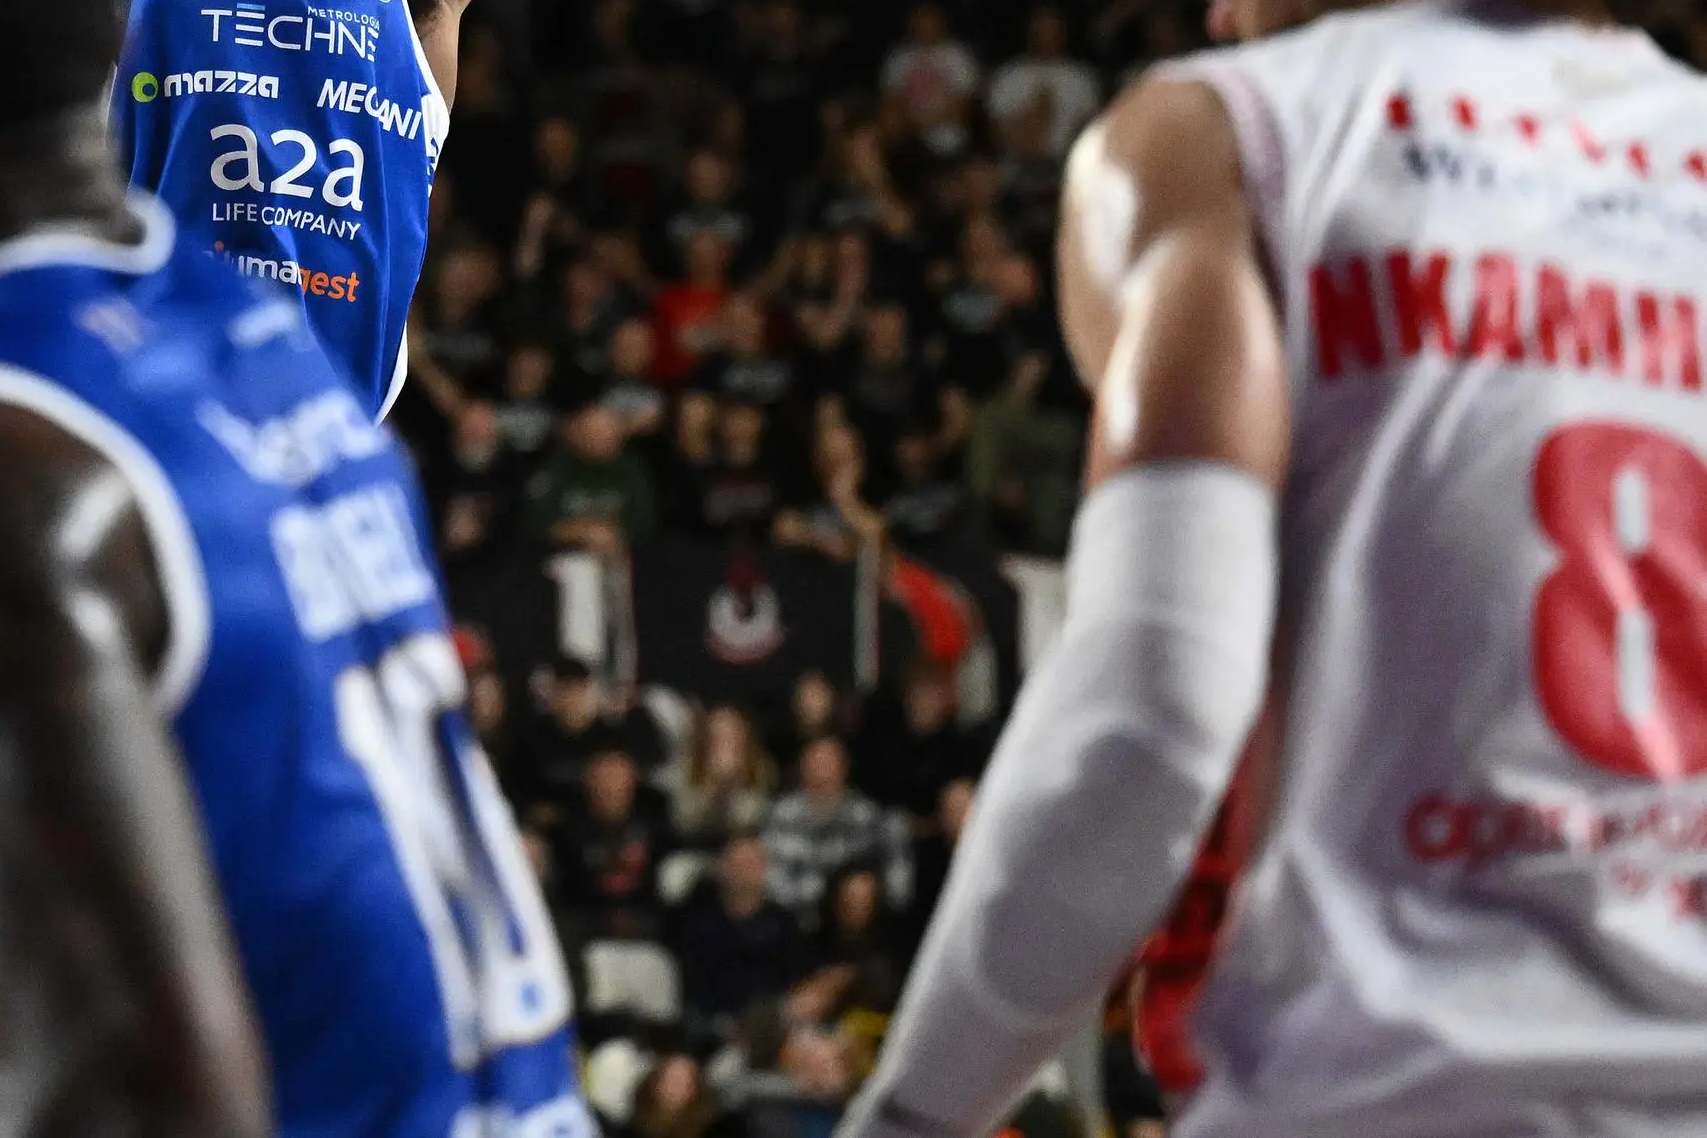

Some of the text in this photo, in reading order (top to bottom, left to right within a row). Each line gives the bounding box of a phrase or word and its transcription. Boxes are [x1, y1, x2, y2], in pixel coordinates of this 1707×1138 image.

[163, 70, 279, 99] mazza
[210, 123, 365, 212] a2a
[212, 203, 361, 241] LIFE COMPANY
[1531, 417, 1707, 782] 8
